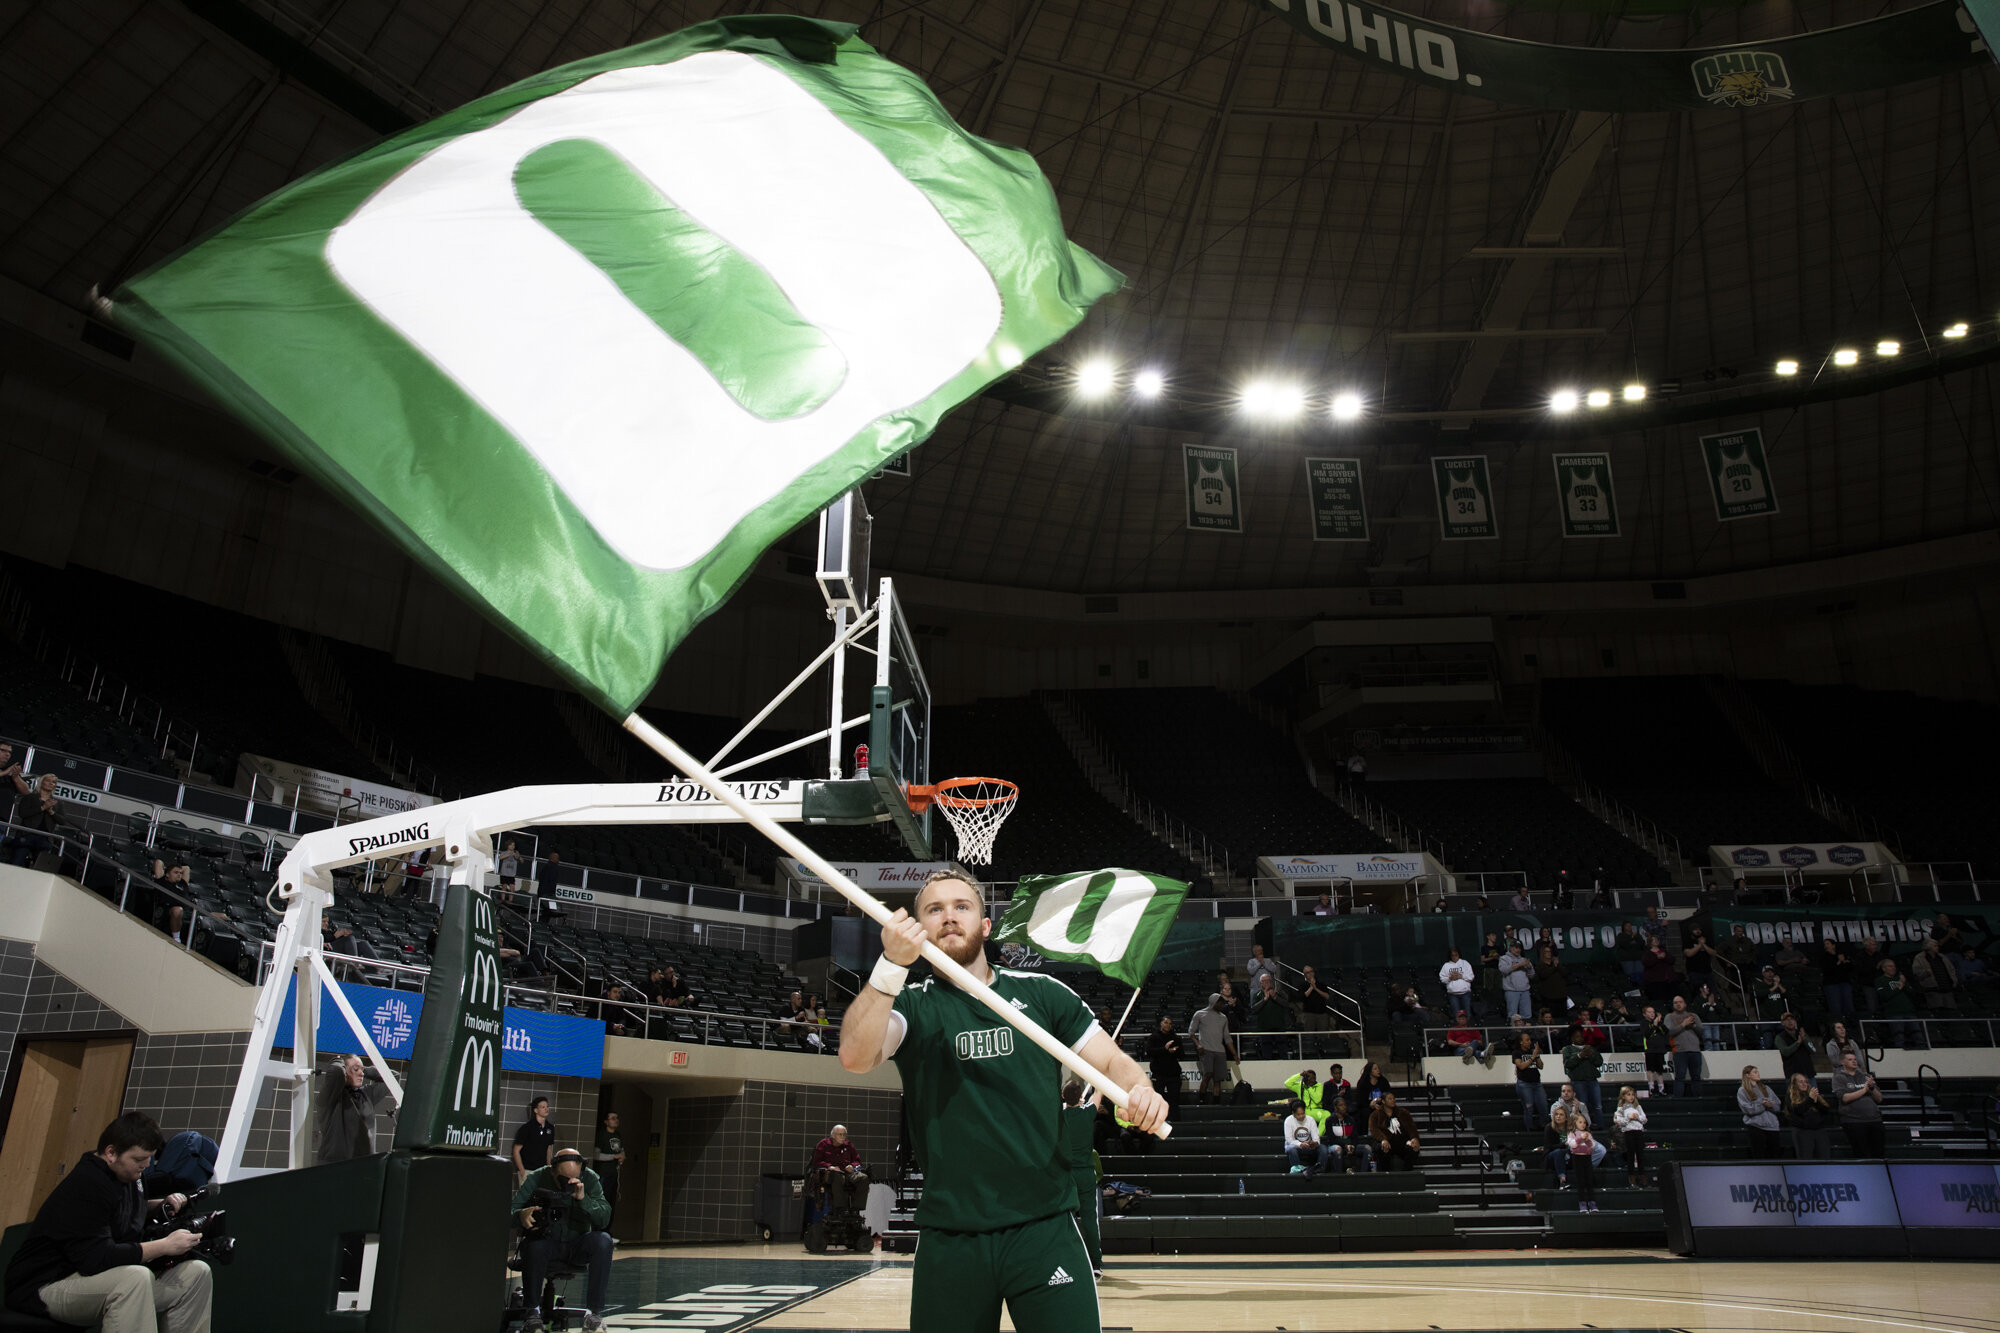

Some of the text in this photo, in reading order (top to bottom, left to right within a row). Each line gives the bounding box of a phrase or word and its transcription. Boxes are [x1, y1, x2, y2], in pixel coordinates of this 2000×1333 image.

[1719, 435, 1744, 447] TRENT
[1188, 449, 1232, 460] BAUMHOLTZ
[1321, 462, 1345, 470] COACH
[1444, 461, 1476, 469] LUCKETT
[1560, 457, 1604, 466] JAMERSON
[1313, 469, 1356, 478] JIM SNYDER
[1726, 463, 1752, 479] OHIO
[1201, 477, 1223, 491] OHIO
[1733, 478, 1751, 492] 20
[1453, 487, 1476, 500] OHIO
[1574, 484, 1598, 498] OHIO
[1205, 492, 1221, 505] 54
[1458, 501, 1476, 514] 34
[1579, 499, 1597, 512] 33
[301, 777, 332, 789] Insurance
[359, 791, 377, 806] THE
[379, 796, 416, 812] PIGSKIN
[349, 822, 429, 856] SPALDING
[878, 866, 936, 881] Tim Hort
[1277, 864, 1338, 874] BAYMONT
[1357, 862, 1418, 872] BAYMONT
[556, 888, 594, 901] SERVED
[1569, 925, 1596, 950] OF
[1822, 918, 1936, 944] ATHLETICS
[1009, 953, 1044, 969] Club
[955, 1026, 1014, 1061] OHIO
[673, 1052, 687, 1065] EXIT
[1626, 1062, 1647, 1073] SECTI
[1180, 1071, 1203, 1081] ECTIO
[445, 1124, 494, 1148] i'm lovin' it
[1729, 1183, 1861, 1203] MARK PORTER
[1941, 1183, 1998, 1202] MARK
[1752, 1196, 1840, 1218] Autoplex
[1048, 1276, 1074, 1286] adidas
